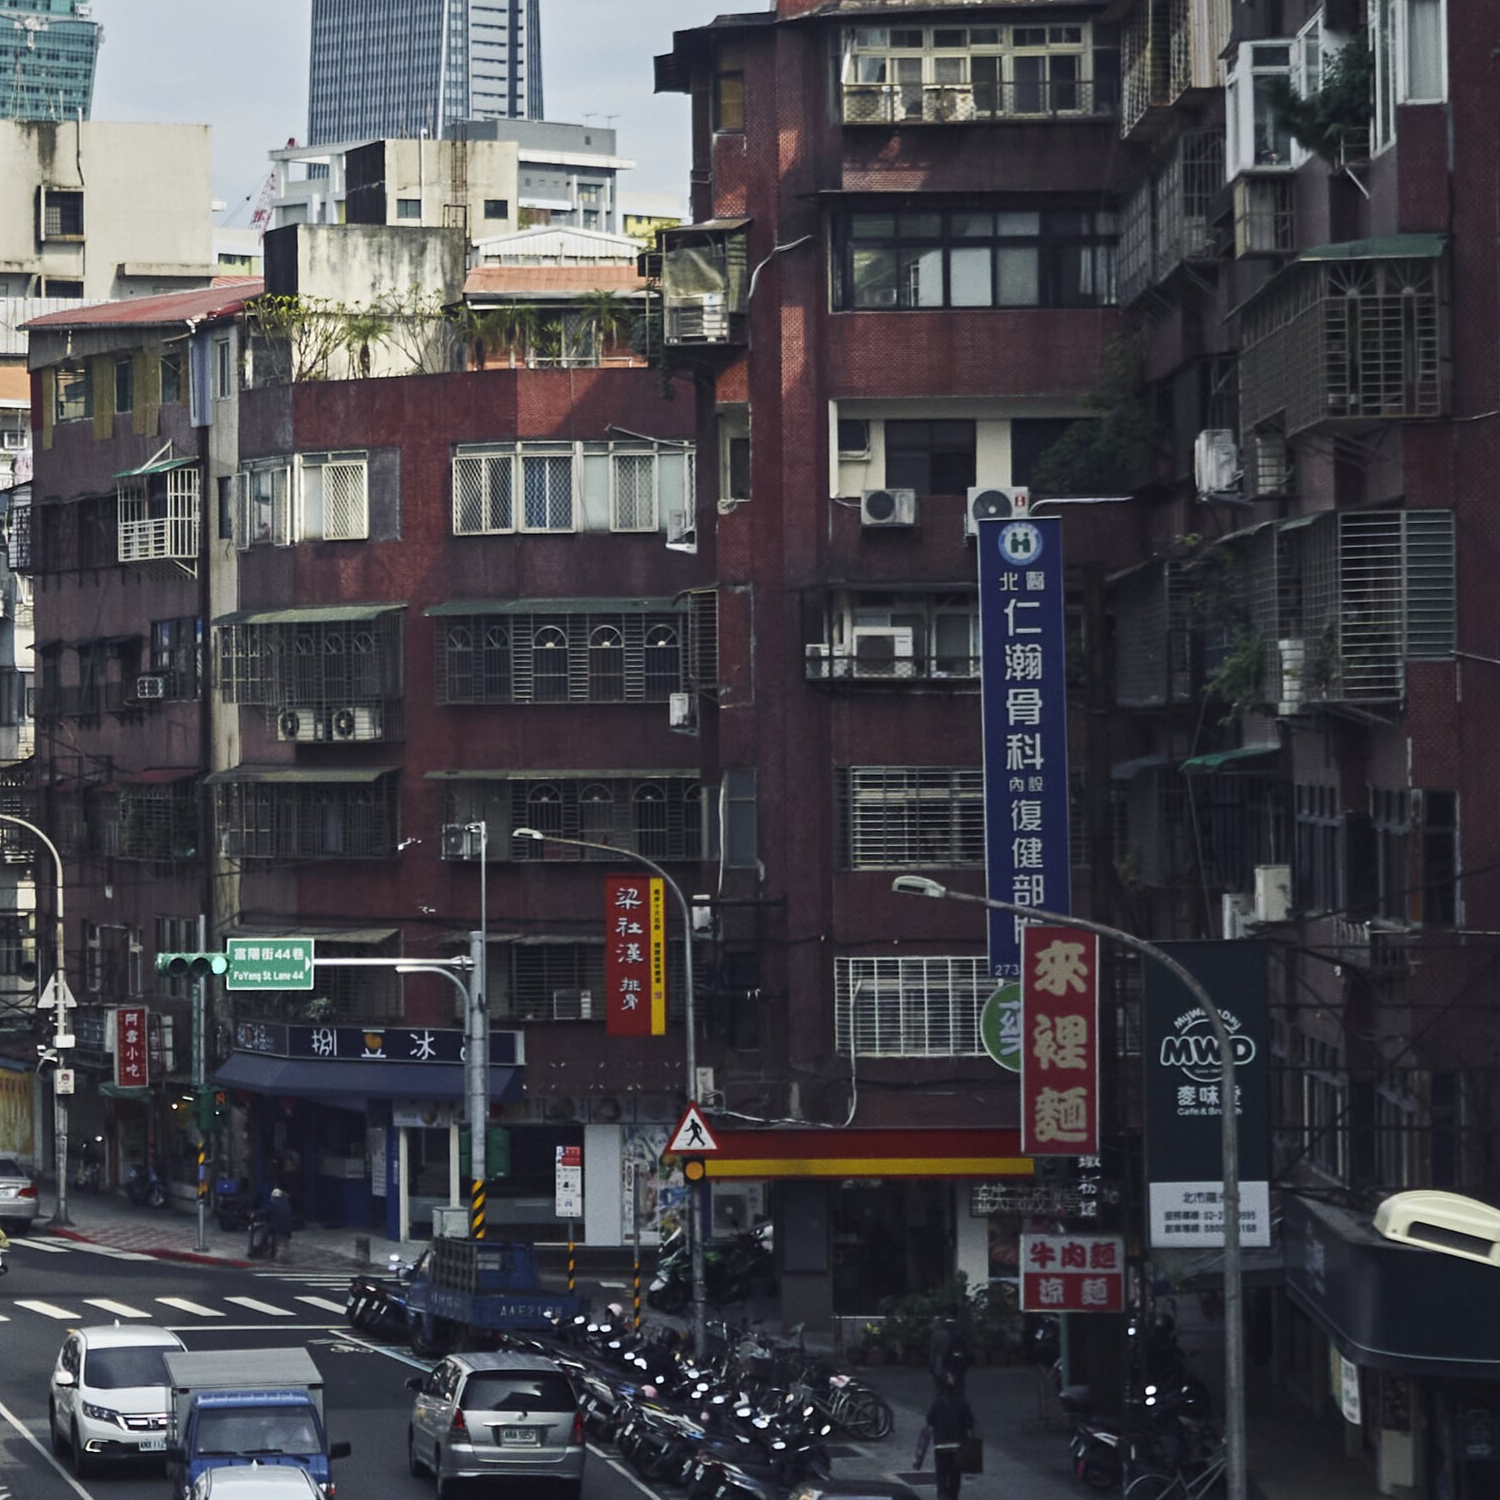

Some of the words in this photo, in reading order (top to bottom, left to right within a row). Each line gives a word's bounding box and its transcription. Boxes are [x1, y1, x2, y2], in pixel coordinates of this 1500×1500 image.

[1004, 598, 1044, 772] 仁瀚骨科
[615, 887, 643, 963] 梁社漢
[234, 947, 304, 960] 富陽街44巷
[273, 971, 291, 980] Lane
[292, 971, 304, 980] 44
[1033, 939, 1088, 1144] 來裡麵
[1160, 1036, 1256, 1066] MWD
[1029, 1241, 1116, 1269] 牛肉麵
